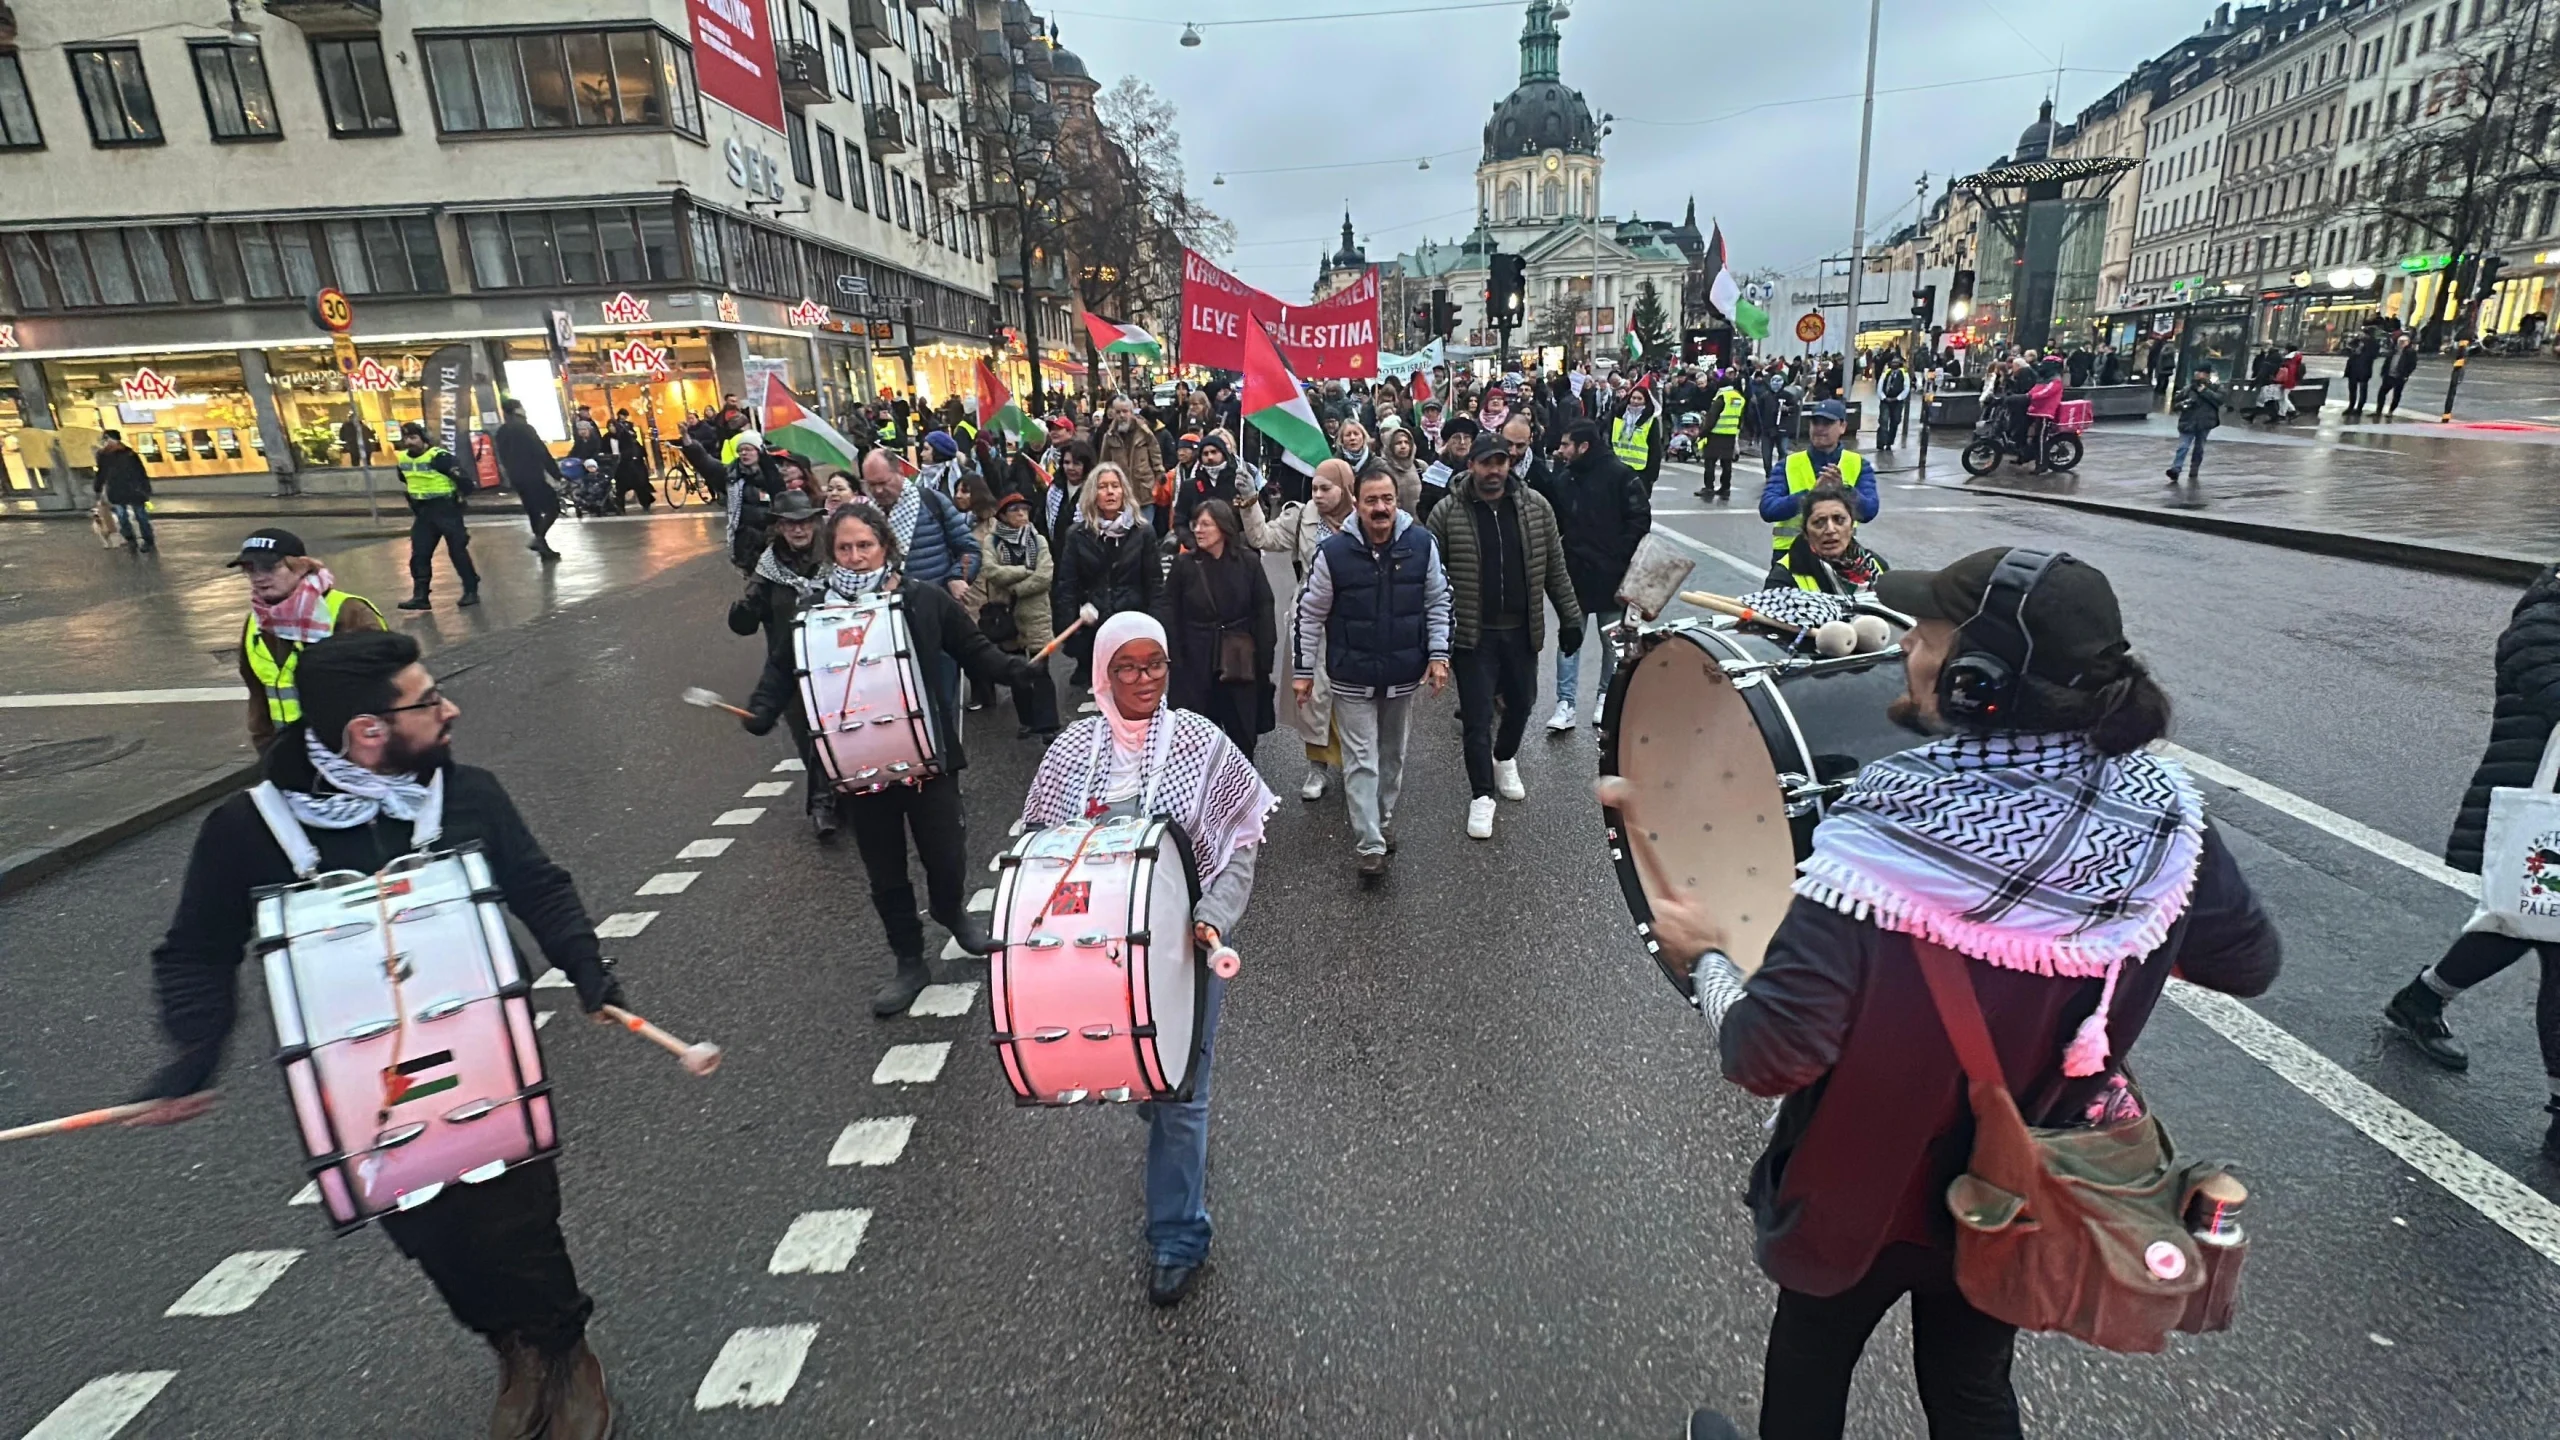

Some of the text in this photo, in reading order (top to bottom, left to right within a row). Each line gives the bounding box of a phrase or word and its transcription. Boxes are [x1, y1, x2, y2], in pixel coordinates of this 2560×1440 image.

[723, 137, 785, 202] SEB
[324, 299, 347, 320] 30
[602, 292, 652, 323] MAX
[788, 297, 830, 326] MAX
[1192, 304, 1373, 349] LEVE PALESTINA
[610, 339, 670, 373] MAX
[121, 367, 178, 404] MAX
[349, 356, 401, 393] MAX
[2520, 900, 2560, 917] PALE
